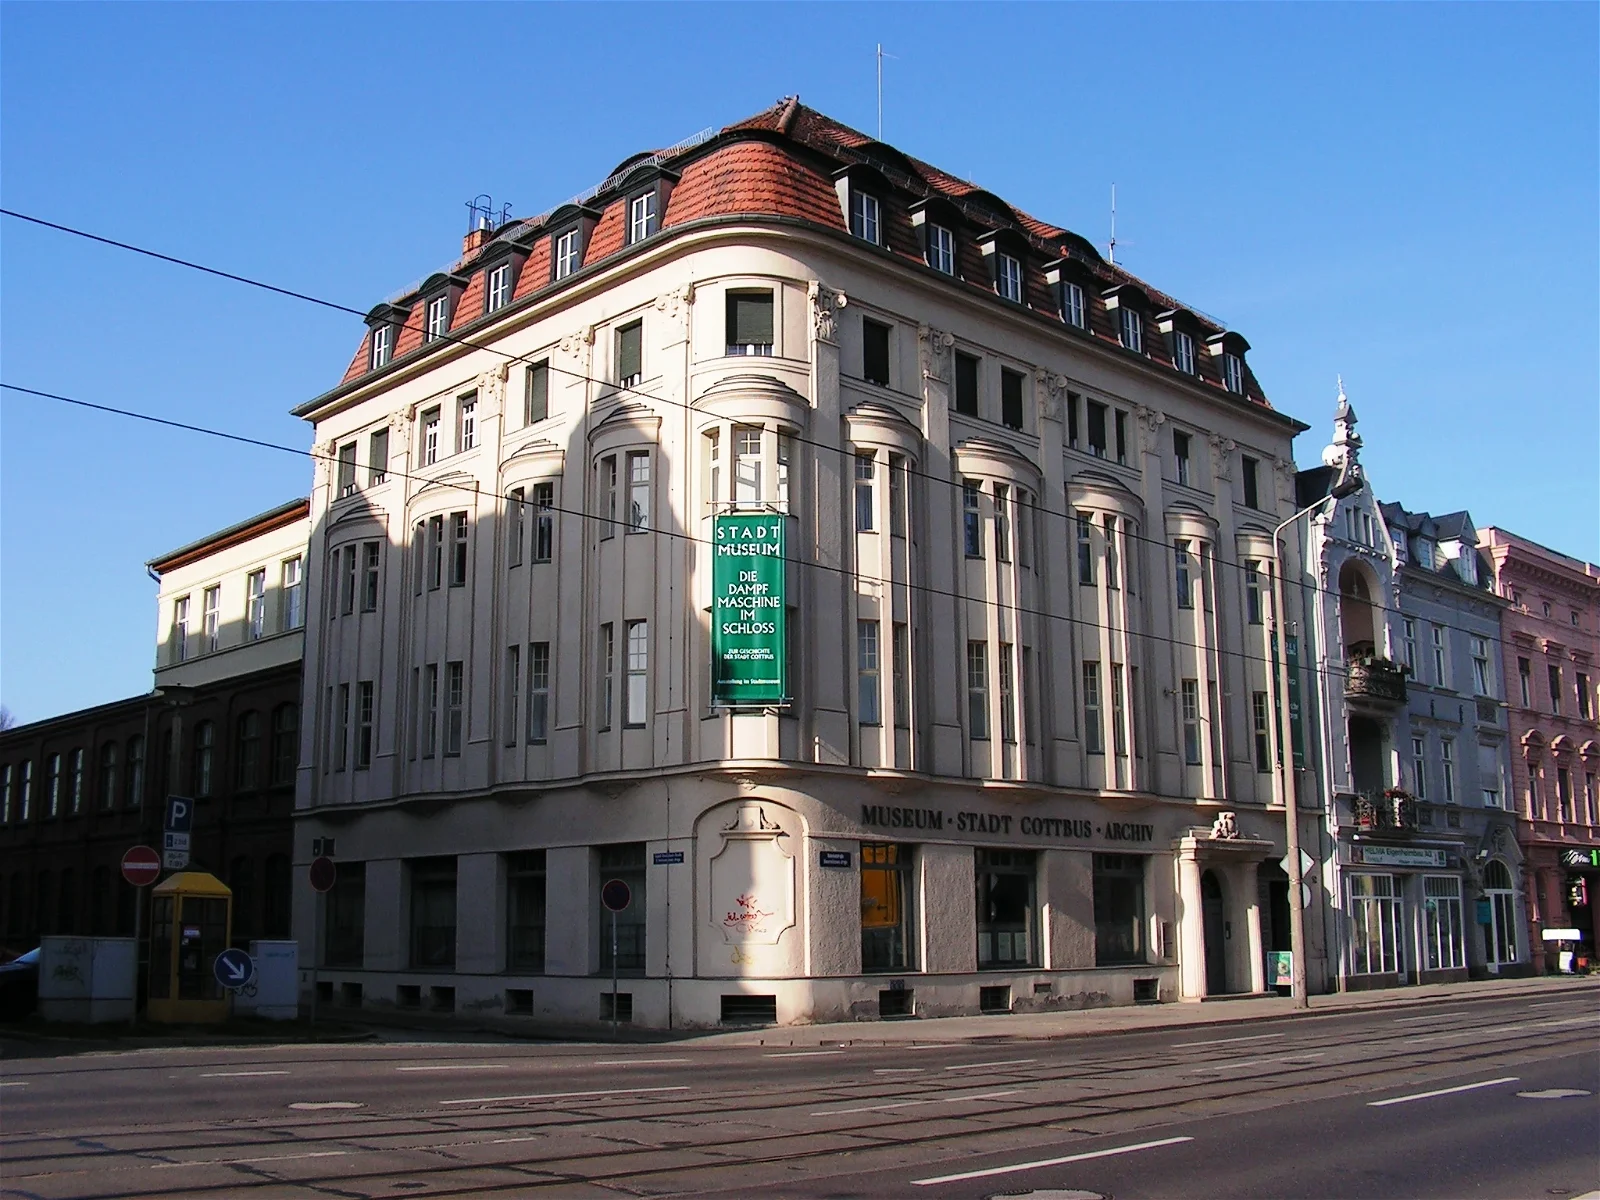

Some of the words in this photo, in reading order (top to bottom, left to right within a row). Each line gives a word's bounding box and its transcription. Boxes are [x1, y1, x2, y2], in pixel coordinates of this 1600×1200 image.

[717, 526, 780, 539] STADT
[717, 543, 780, 556] MUSEUM
[739, 571, 758, 582] DIE
[728, 583, 769, 595] DAMPF
[717, 597, 780, 608] MASCHINE
[740, 609, 755, 621] IM
[722, 622, 775, 634] SCHLOSS
[171, 801, 187, 828] P
[861, 804, 943, 830] MUSEUM
[957, 811, 1013, 835] STADT
[1020, 816, 1092, 839] COTTBUS
[1104, 821, 1154, 841] ARCHIV
